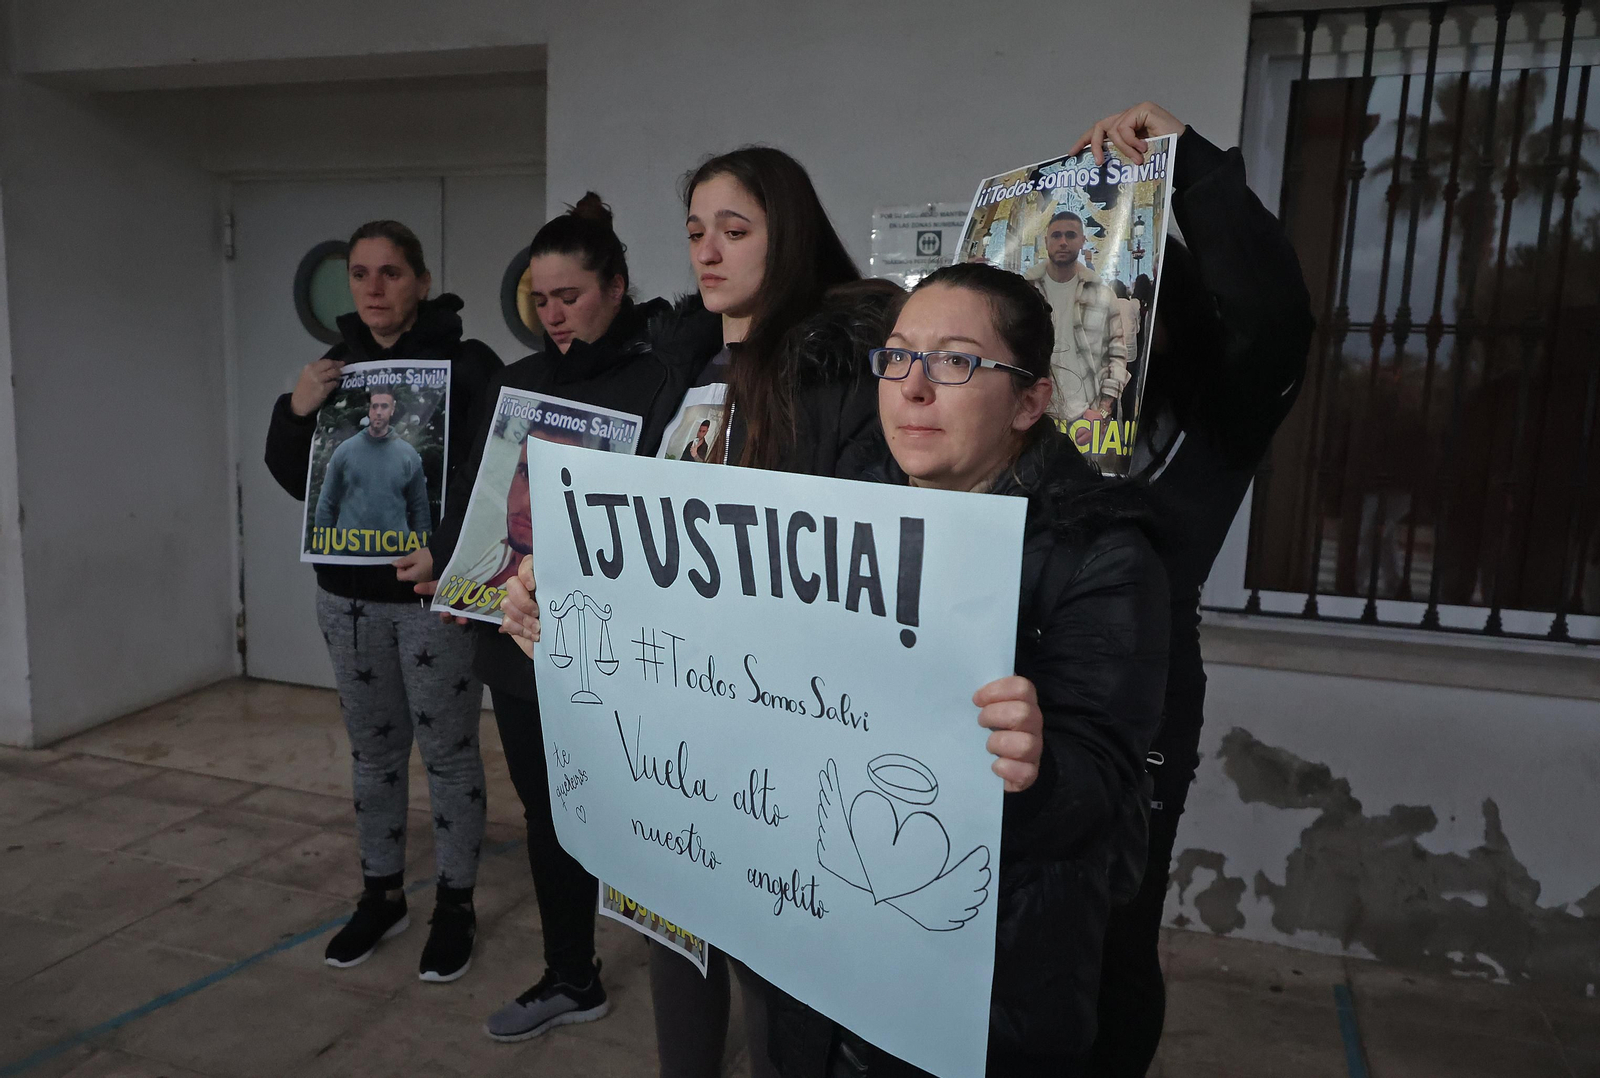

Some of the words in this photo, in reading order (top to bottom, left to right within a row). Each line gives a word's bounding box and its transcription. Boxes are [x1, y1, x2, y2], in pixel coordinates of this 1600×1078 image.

[976, 180, 1035, 208] ¡¡Todos
[1036, 168, 1100, 191] somos
[1106, 152, 1167, 186] Salvi!!
[366, 373, 402, 386] somos
[405, 368, 445, 387] Salvi!!
[500, 396, 543, 423] ¡¡Todos
[544, 411, 587, 432] somos
[589, 416, 636, 444] Salvi!!
[560, 467, 925, 648] ¡JUSTICIA!
[553, 742, 570, 768] te
[614, 710, 718, 802] Vuela
[733, 769, 789, 827] alto
[631, 818, 722, 870] nuestro
[747, 867, 830, 920] angelito
